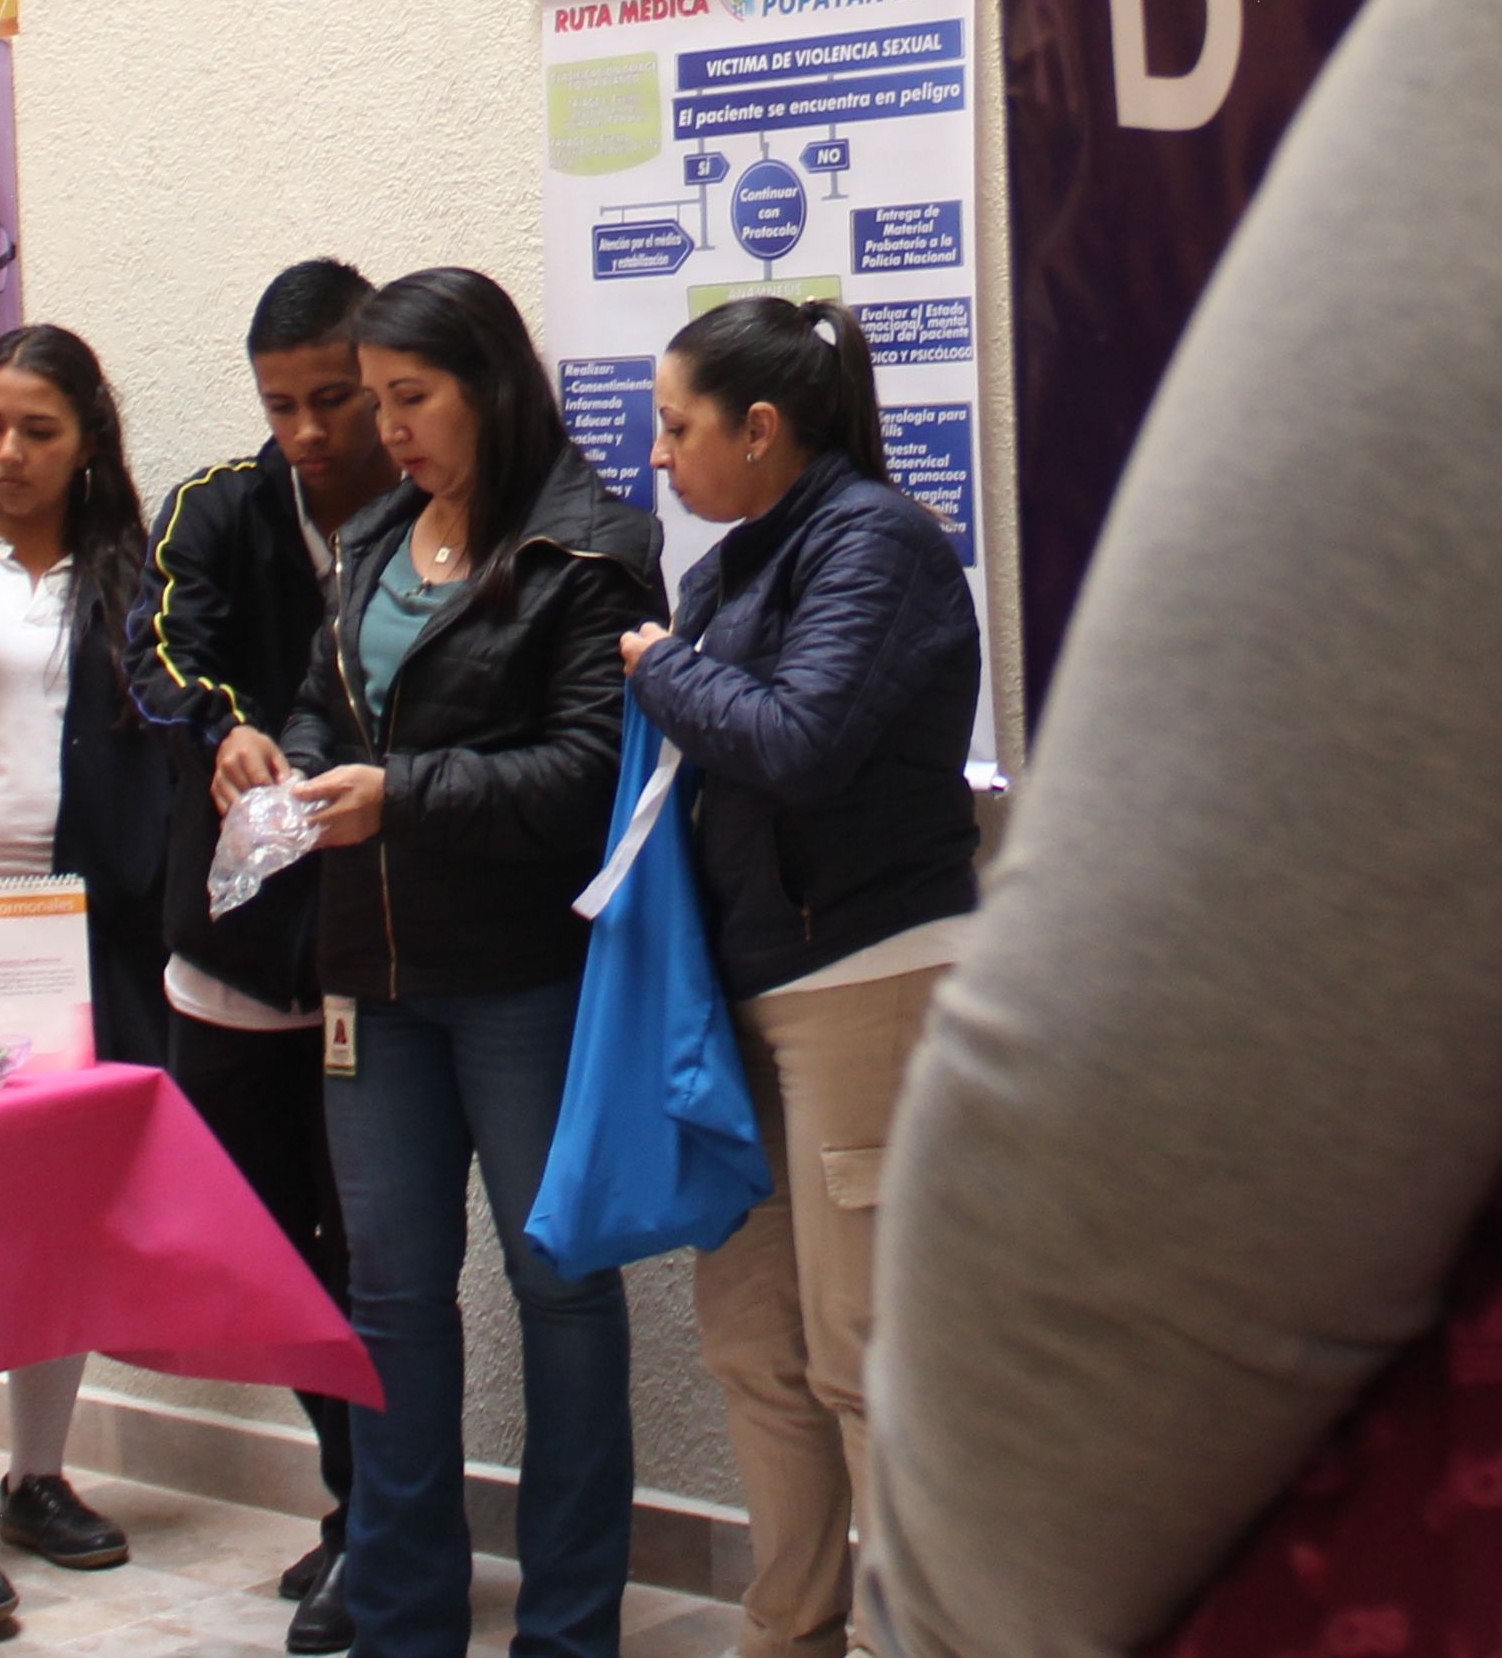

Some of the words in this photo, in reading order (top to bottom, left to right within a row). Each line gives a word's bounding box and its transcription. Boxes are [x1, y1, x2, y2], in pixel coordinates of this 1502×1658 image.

[554, 3, 613, 33] RUTA
[706, 55, 769, 78] VICTIMA
[771, 51, 792, 70] DE
[795, 41, 878, 67] VIOLENCIA
[882, 33, 942, 57] SEXUAL
[678, 108, 694, 127] El
[695, 103, 763, 129] paciente
[767, 101, 785, 117] se
[789, 93, 870, 115] encuentra
[875, 91, 895, 106] en
[899, 81, 960, 107] peligro
[817, 148, 841, 165] NO
[739, 185, 799, 202] Continuar
[758, 207, 780, 220] con
[876, 209, 921, 223] Entrega
[924, 205, 940, 218] de
[741, 222, 798, 241] Protocolo
[882, 220, 934, 237] Material
[864, 237, 927, 253] Probatorio
[929, 238, 938, 249] a
[941, 234, 953, 247] la
[904, 248, 957, 266] Nacional
[861, 306, 908, 322] Evaluar
[927, 315, 967, 329] mental
[897, 328, 917, 343] del
[919, 326, 969, 344] paciente
[871, 351, 898, 364] DICO
[900, 350, 909, 363] Y
[910, 344, 973, 363] PSICÓLOGO
[574, 413, 612, 428] Educar
[614, 412, 626, 427] al
[937, 409, 967, 425] para
[615, 433, 623, 447] y
[886, 453, 951, 470] doservical
[619, 466, 640, 481] por
[908, 470, 967, 486] gonococo
[625, 485, 633, 499] y
[913, 485, 962, 505] vaginal
